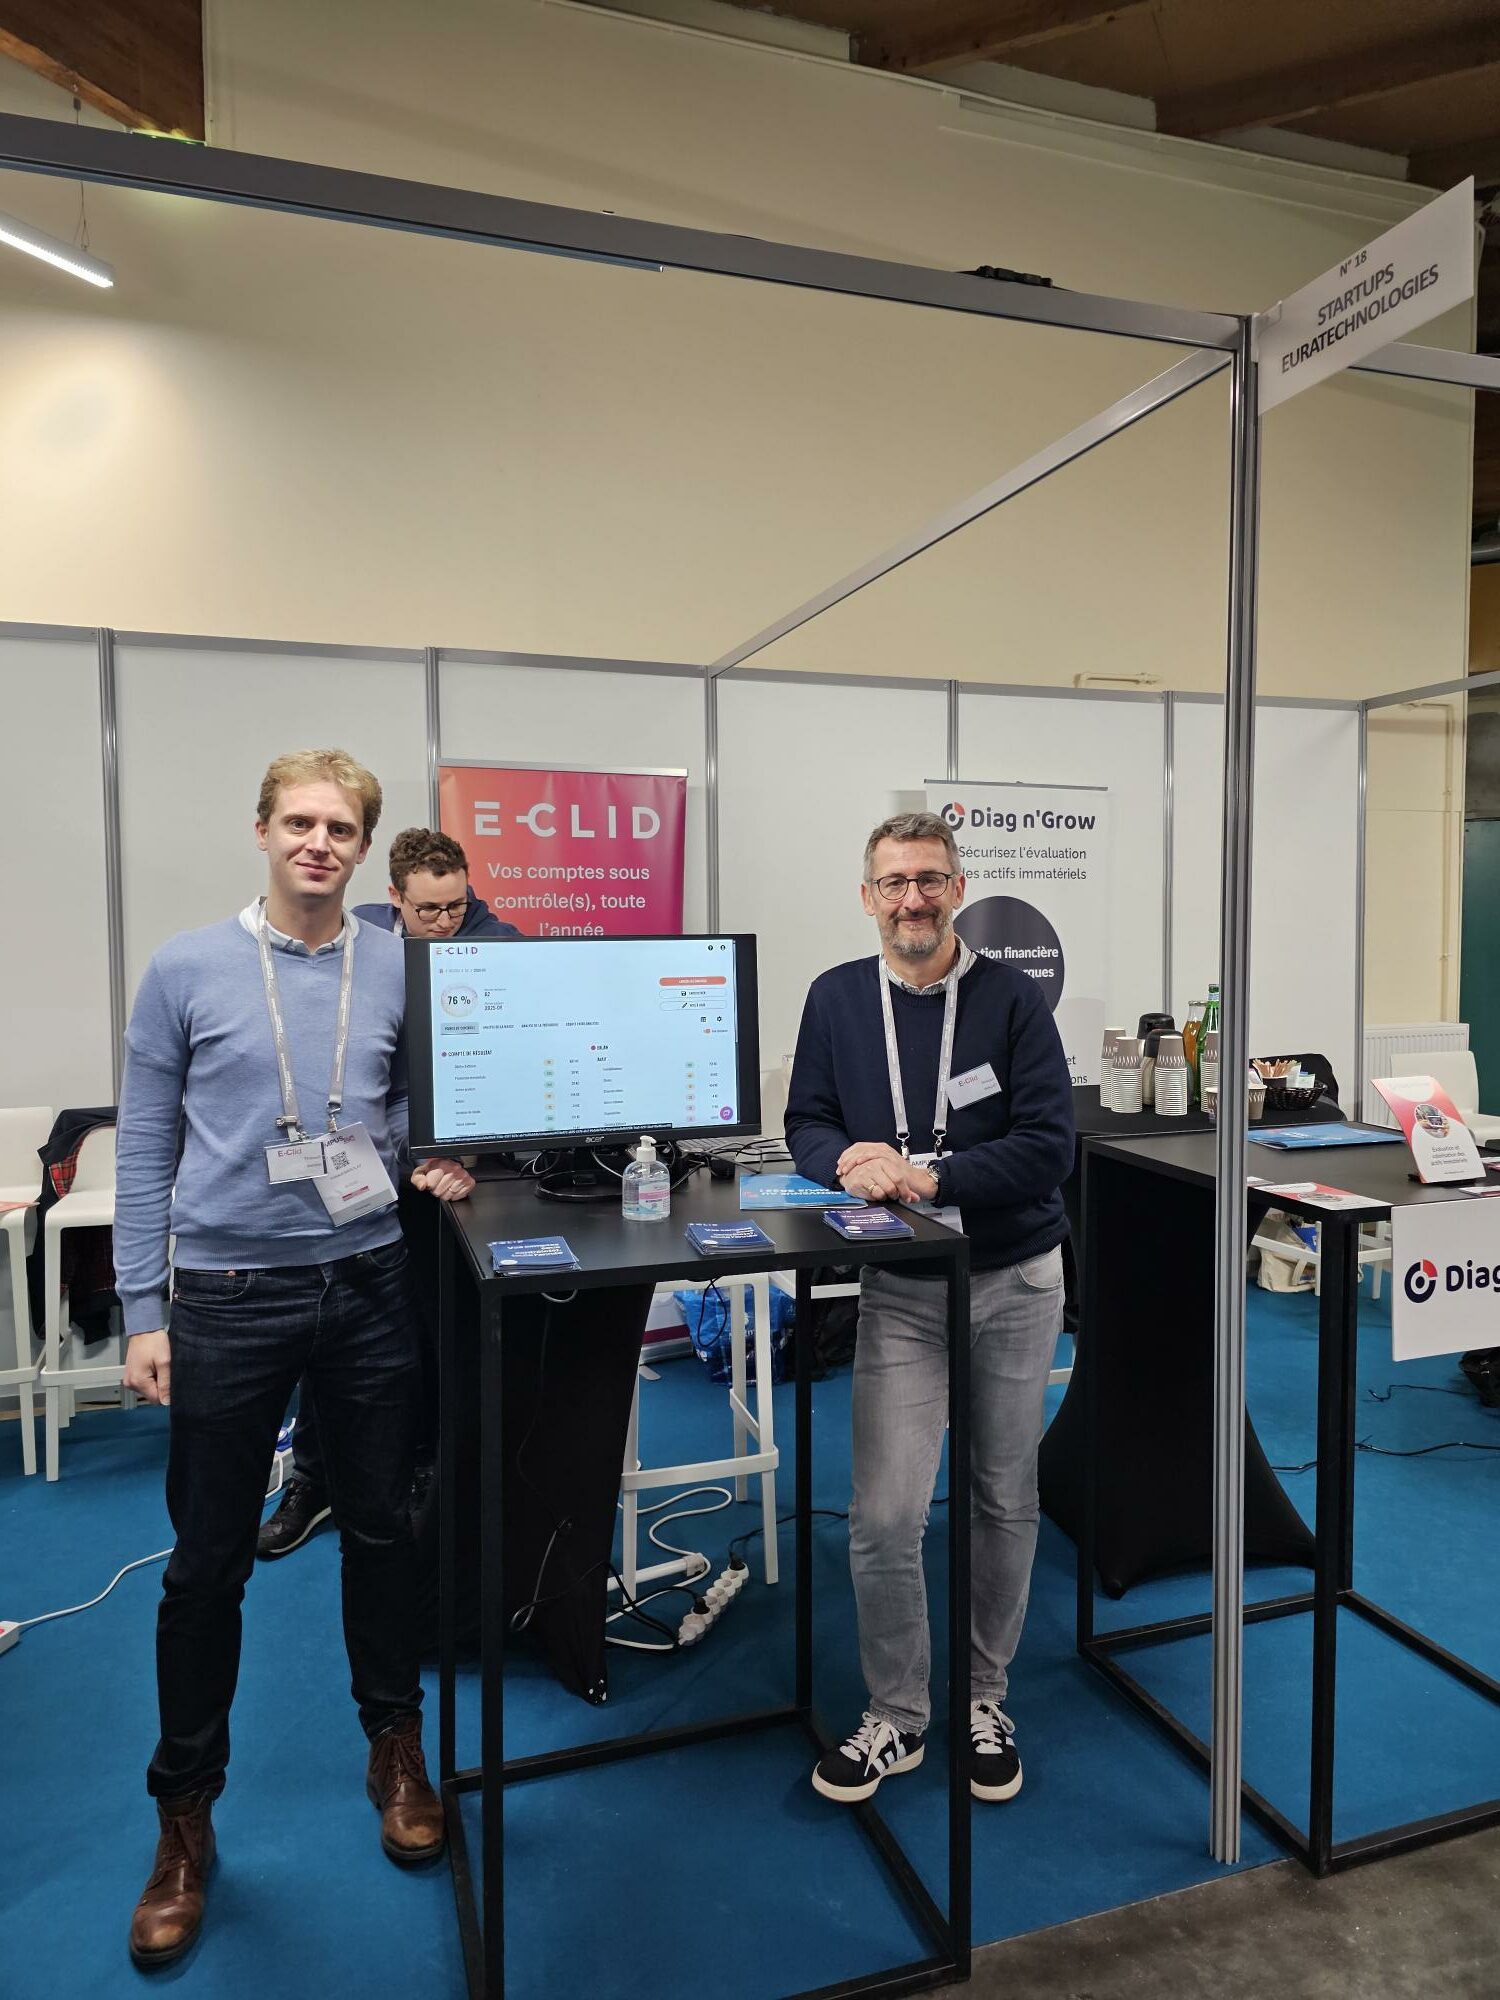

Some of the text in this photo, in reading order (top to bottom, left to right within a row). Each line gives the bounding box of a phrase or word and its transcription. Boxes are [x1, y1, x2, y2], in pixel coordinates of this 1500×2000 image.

[1354, 250, 1368, 269] 18
[1317, 262, 1395, 327] STARTUPS
[1281, 263, 1439, 374] EURATECHNOLOGIES
[970, 807, 1096, 832] Diag n'Grow
[958, 845, 1087, 860] Sécurisez l'évaluation
[487, 863, 650, 882] Vos comptes sous
[983, 866, 1016, 879] actifs
[1019, 867, 1087, 880] immatériels
[494, 893, 646, 913] contrôle(s), toute
[1004, 945, 1059, 959] financière
[447, 995, 471, 1005] 76 %
[585, 1136, 605, 1144] acer
